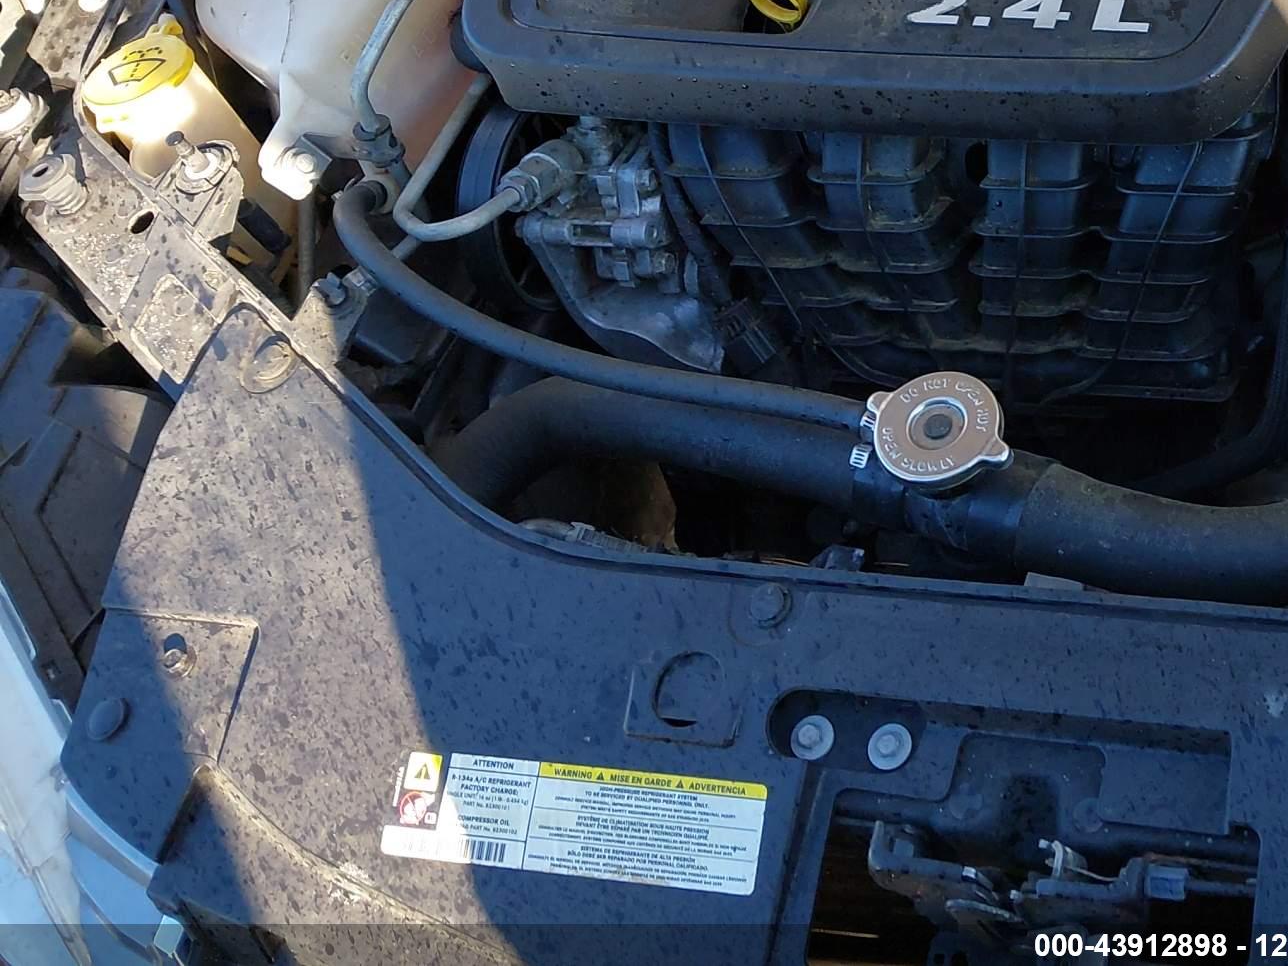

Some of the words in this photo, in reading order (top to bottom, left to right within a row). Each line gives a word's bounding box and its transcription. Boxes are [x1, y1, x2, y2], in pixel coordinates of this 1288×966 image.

[900, 390, 919, 403] DO
[923, 378, 949, 391] NOT
[882, 427, 902, 459] OPEN
[901, 455, 956, 472] SLOWLY
[473, 759, 514, 770] ATTENTION
[554, 767, 592, 779] WARNING
[488, 777, 531, 788] REFRIGERANT
[610, 774, 631, 783] MISE
[631, 776, 642, 784] EN
[644, 777, 672, 788] GARDE
[461, 783, 489, 792] FACTORY
[689, 782, 746, 795] ADVERTENCIA
[458, 815, 498, 824] COMPRESSOR
